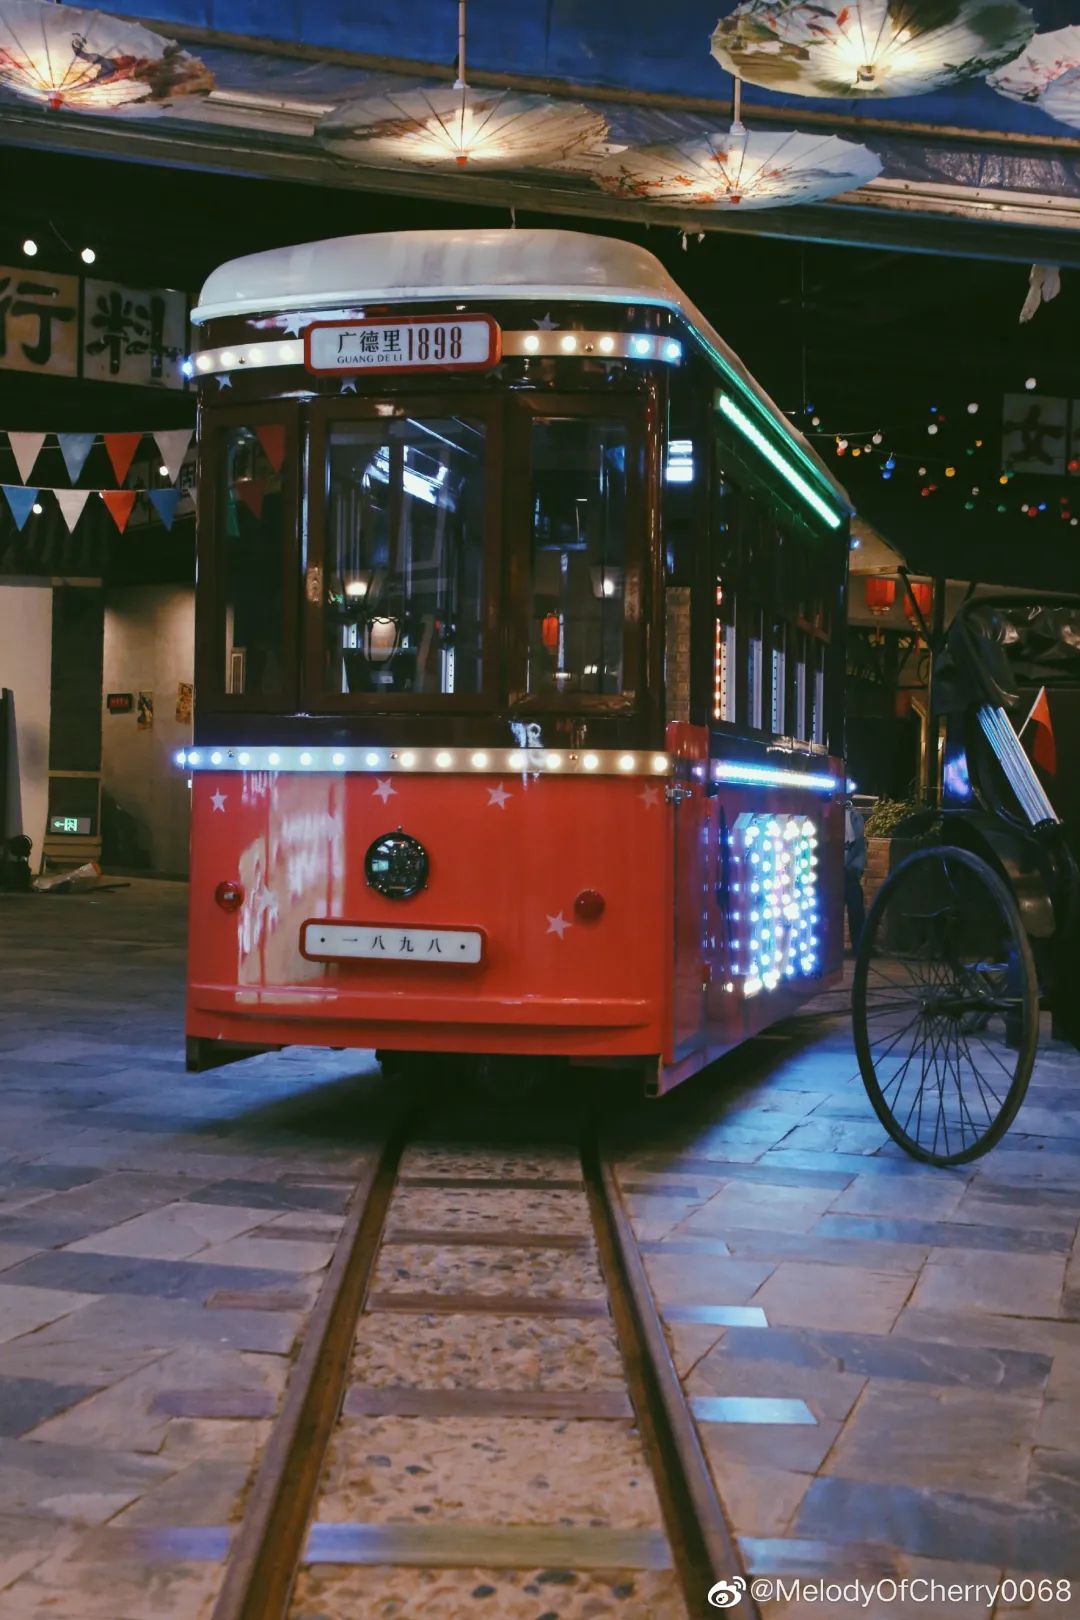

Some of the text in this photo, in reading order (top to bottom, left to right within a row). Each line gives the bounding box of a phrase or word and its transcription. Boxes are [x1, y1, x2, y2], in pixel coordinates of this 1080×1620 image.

[336, 326, 463, 361] 广德里 1898
[337, 353, 403, 364] GUANG DE LI
